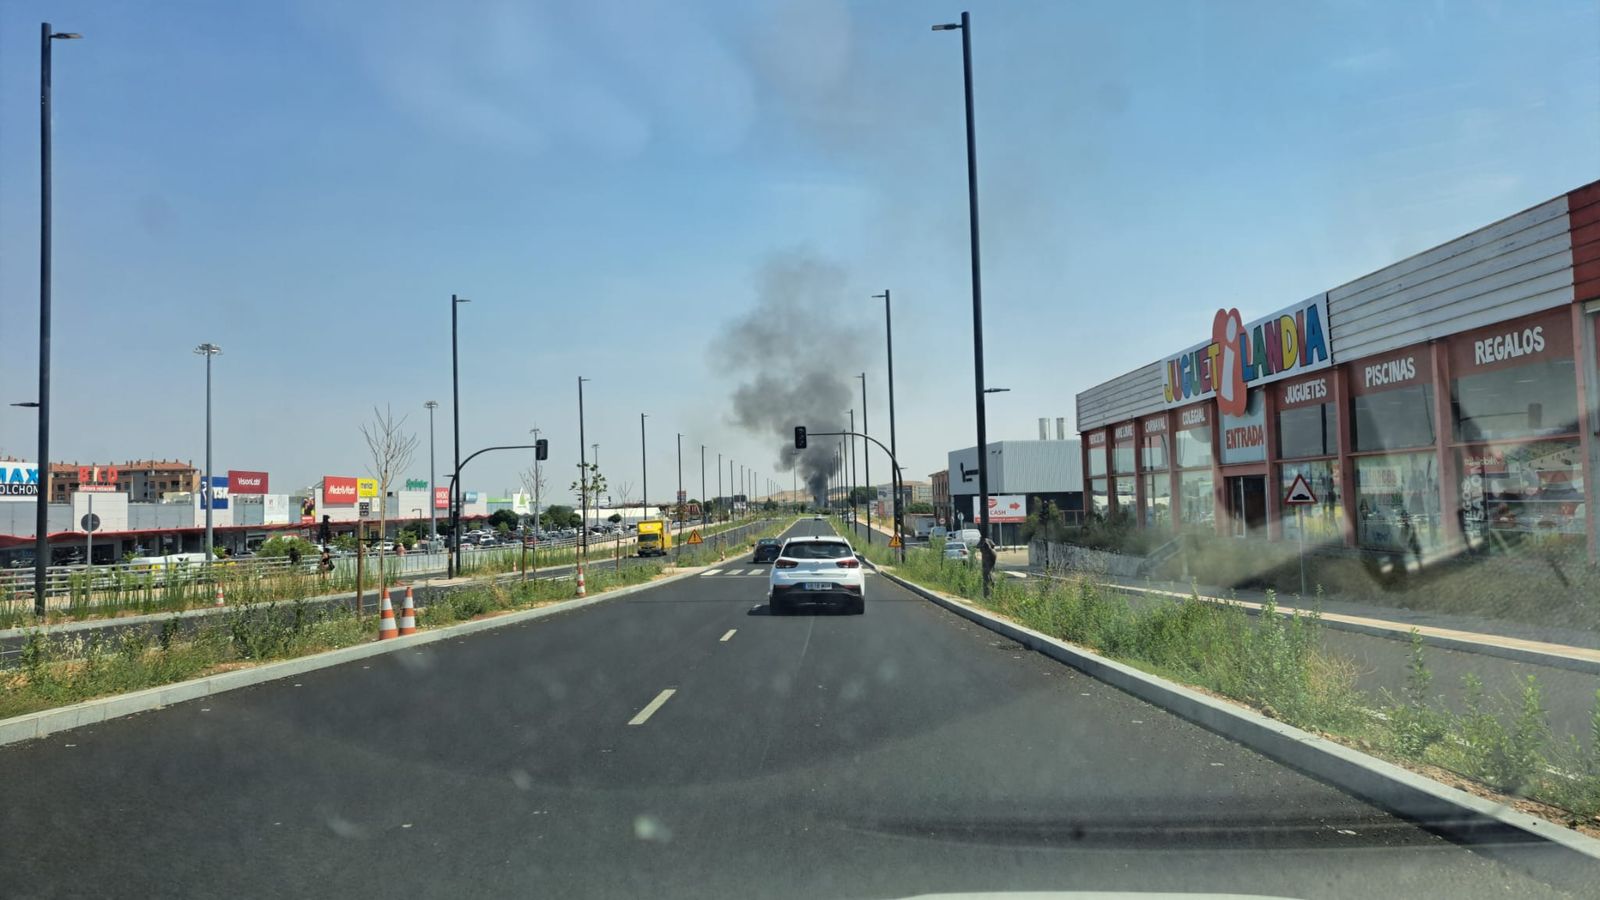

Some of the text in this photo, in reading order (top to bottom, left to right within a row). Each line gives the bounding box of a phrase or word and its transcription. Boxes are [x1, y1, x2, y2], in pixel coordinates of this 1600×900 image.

[1474, 326, 1546, 366] REGALOS
[1365, 357, 1417, 388] PISCINAS
[1285, 378, 1327, 404] JUGUETES
[1181, 407, 1207, 426] COLEGIAL
[1225, 424, 1265, 450] ENTRADA
